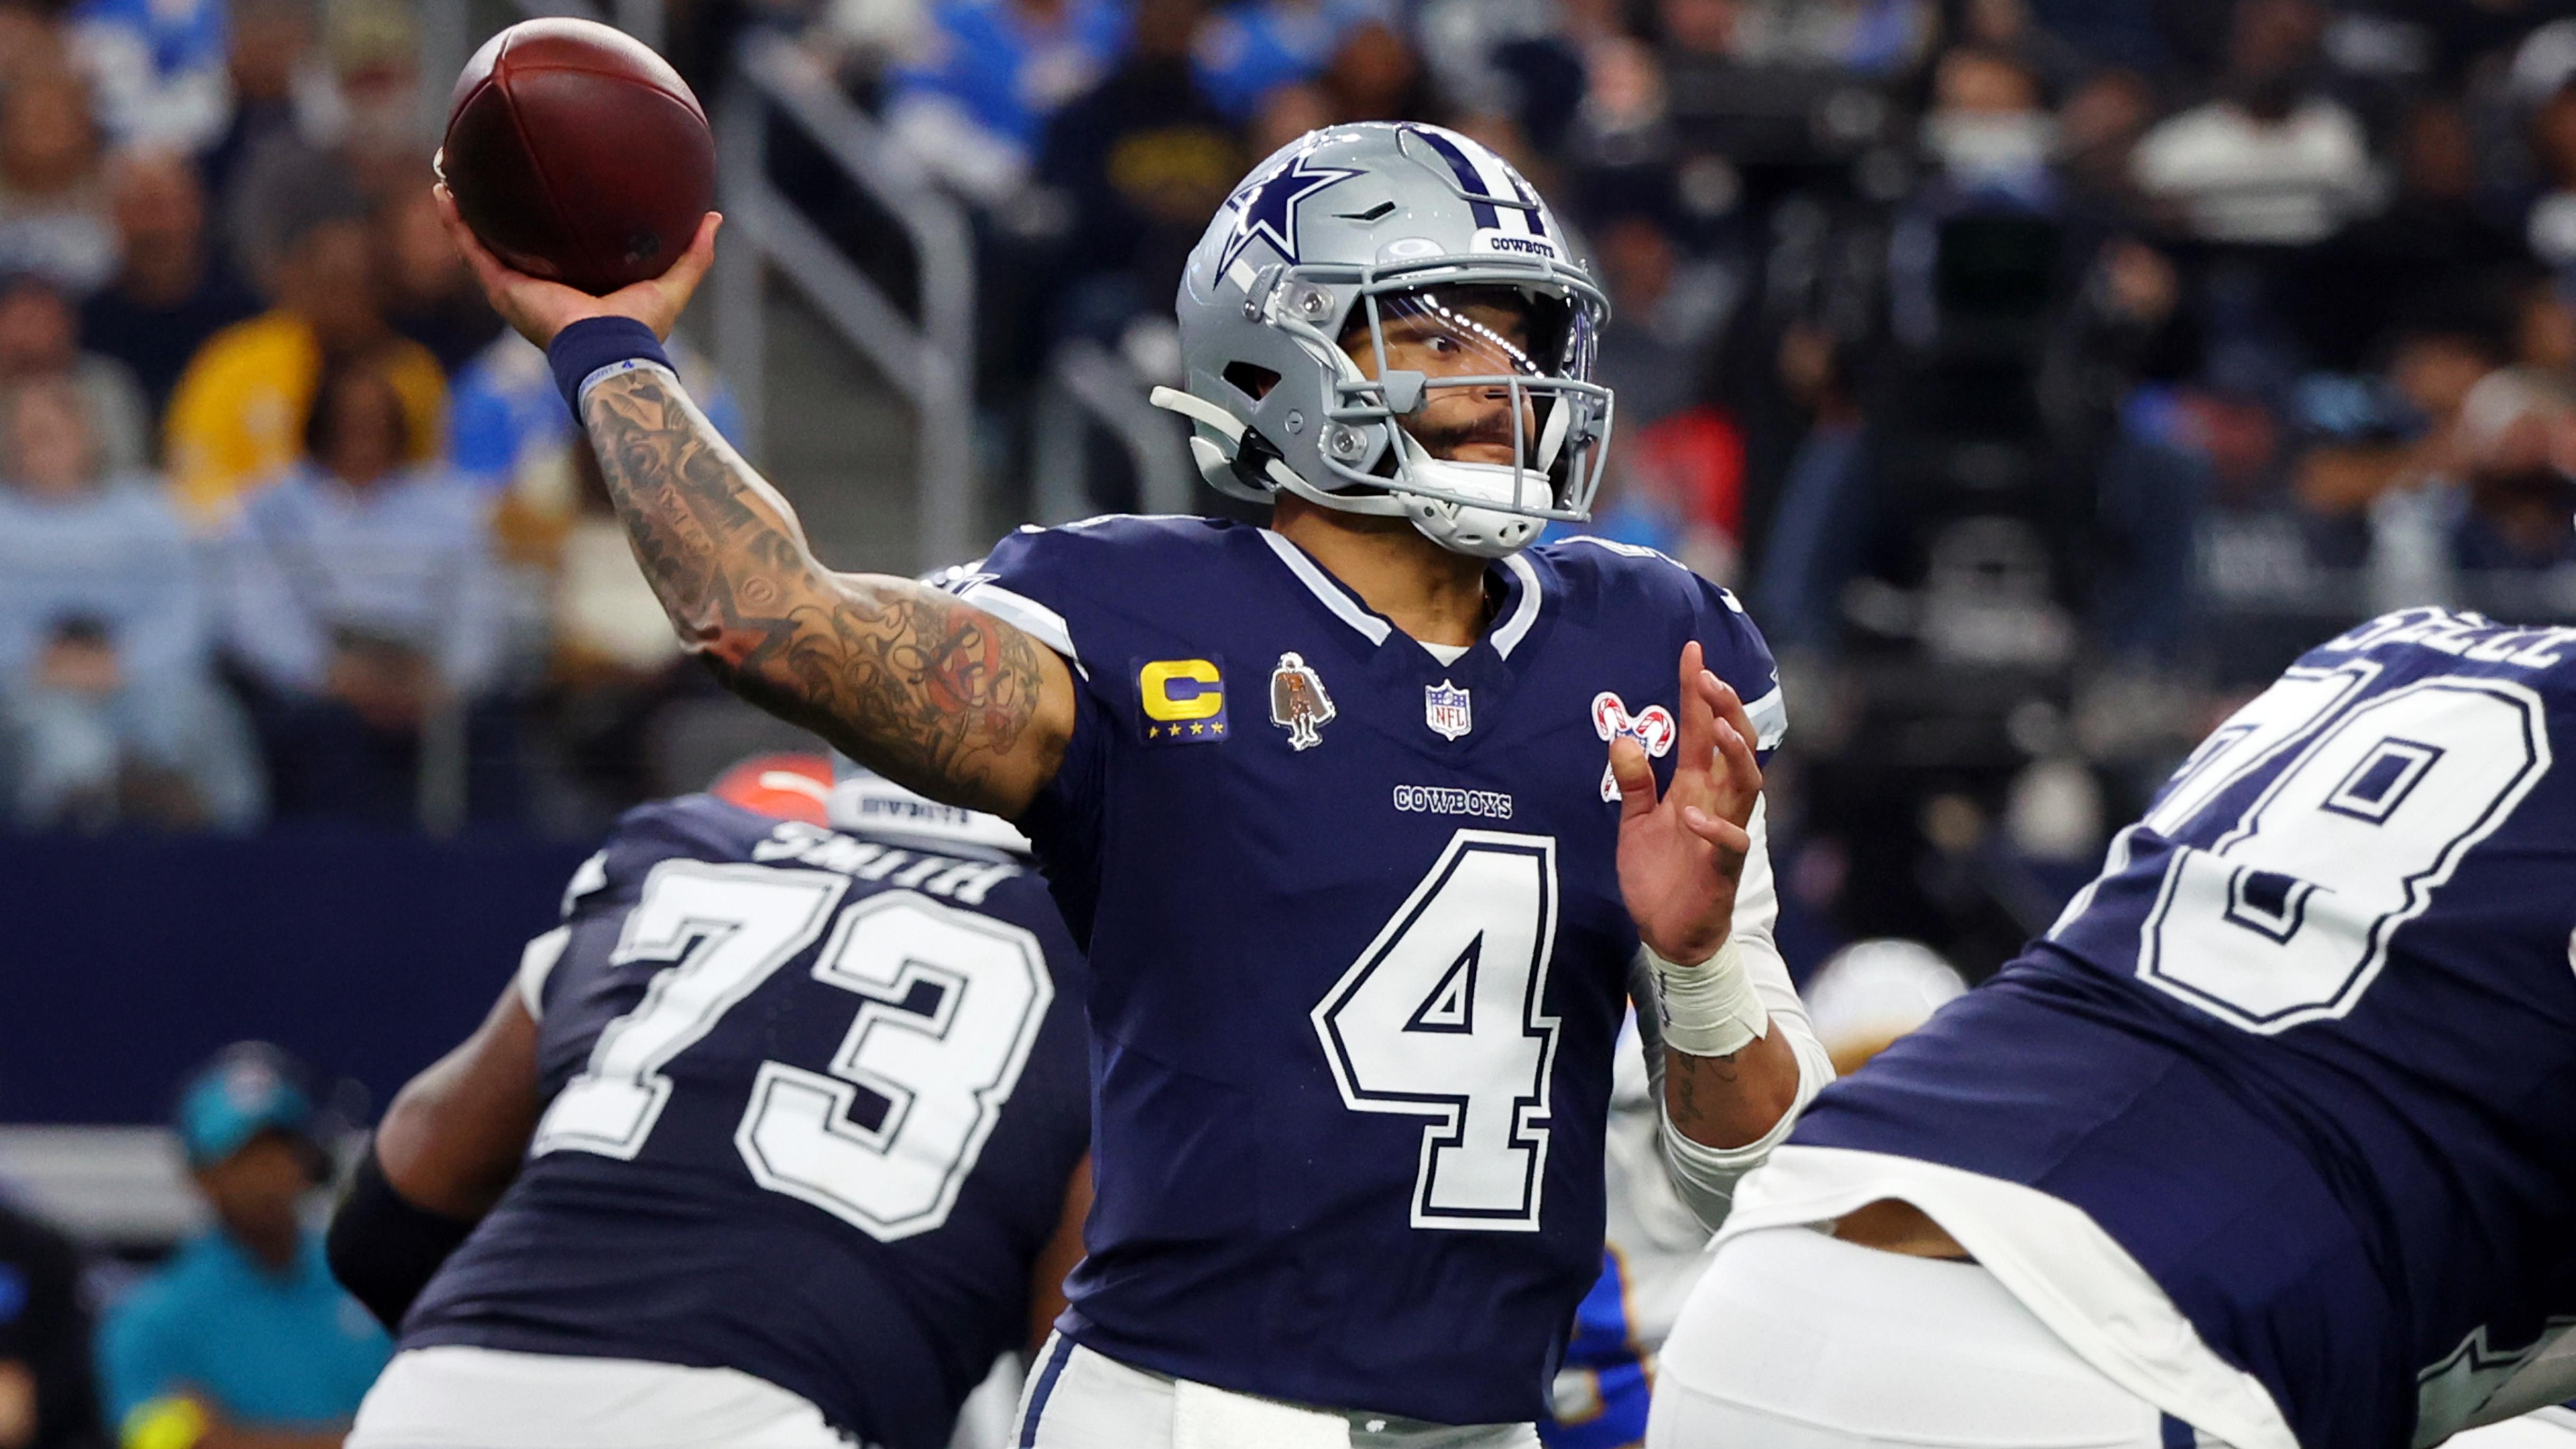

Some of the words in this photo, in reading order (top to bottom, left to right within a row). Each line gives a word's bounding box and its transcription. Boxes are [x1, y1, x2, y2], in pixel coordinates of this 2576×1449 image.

[1491, 237, 1555, 258] COWBOYS
[1140, 659, 1223, 721] C
[1435, 707, 1465, 728] NFL
[1393, 785, 1512, 819] COWBOYS
[2049, 657, 2552, 1035] 78
[531, 858, 1055, 1243] 73
[1309, 828, 1562, 1232] 4
